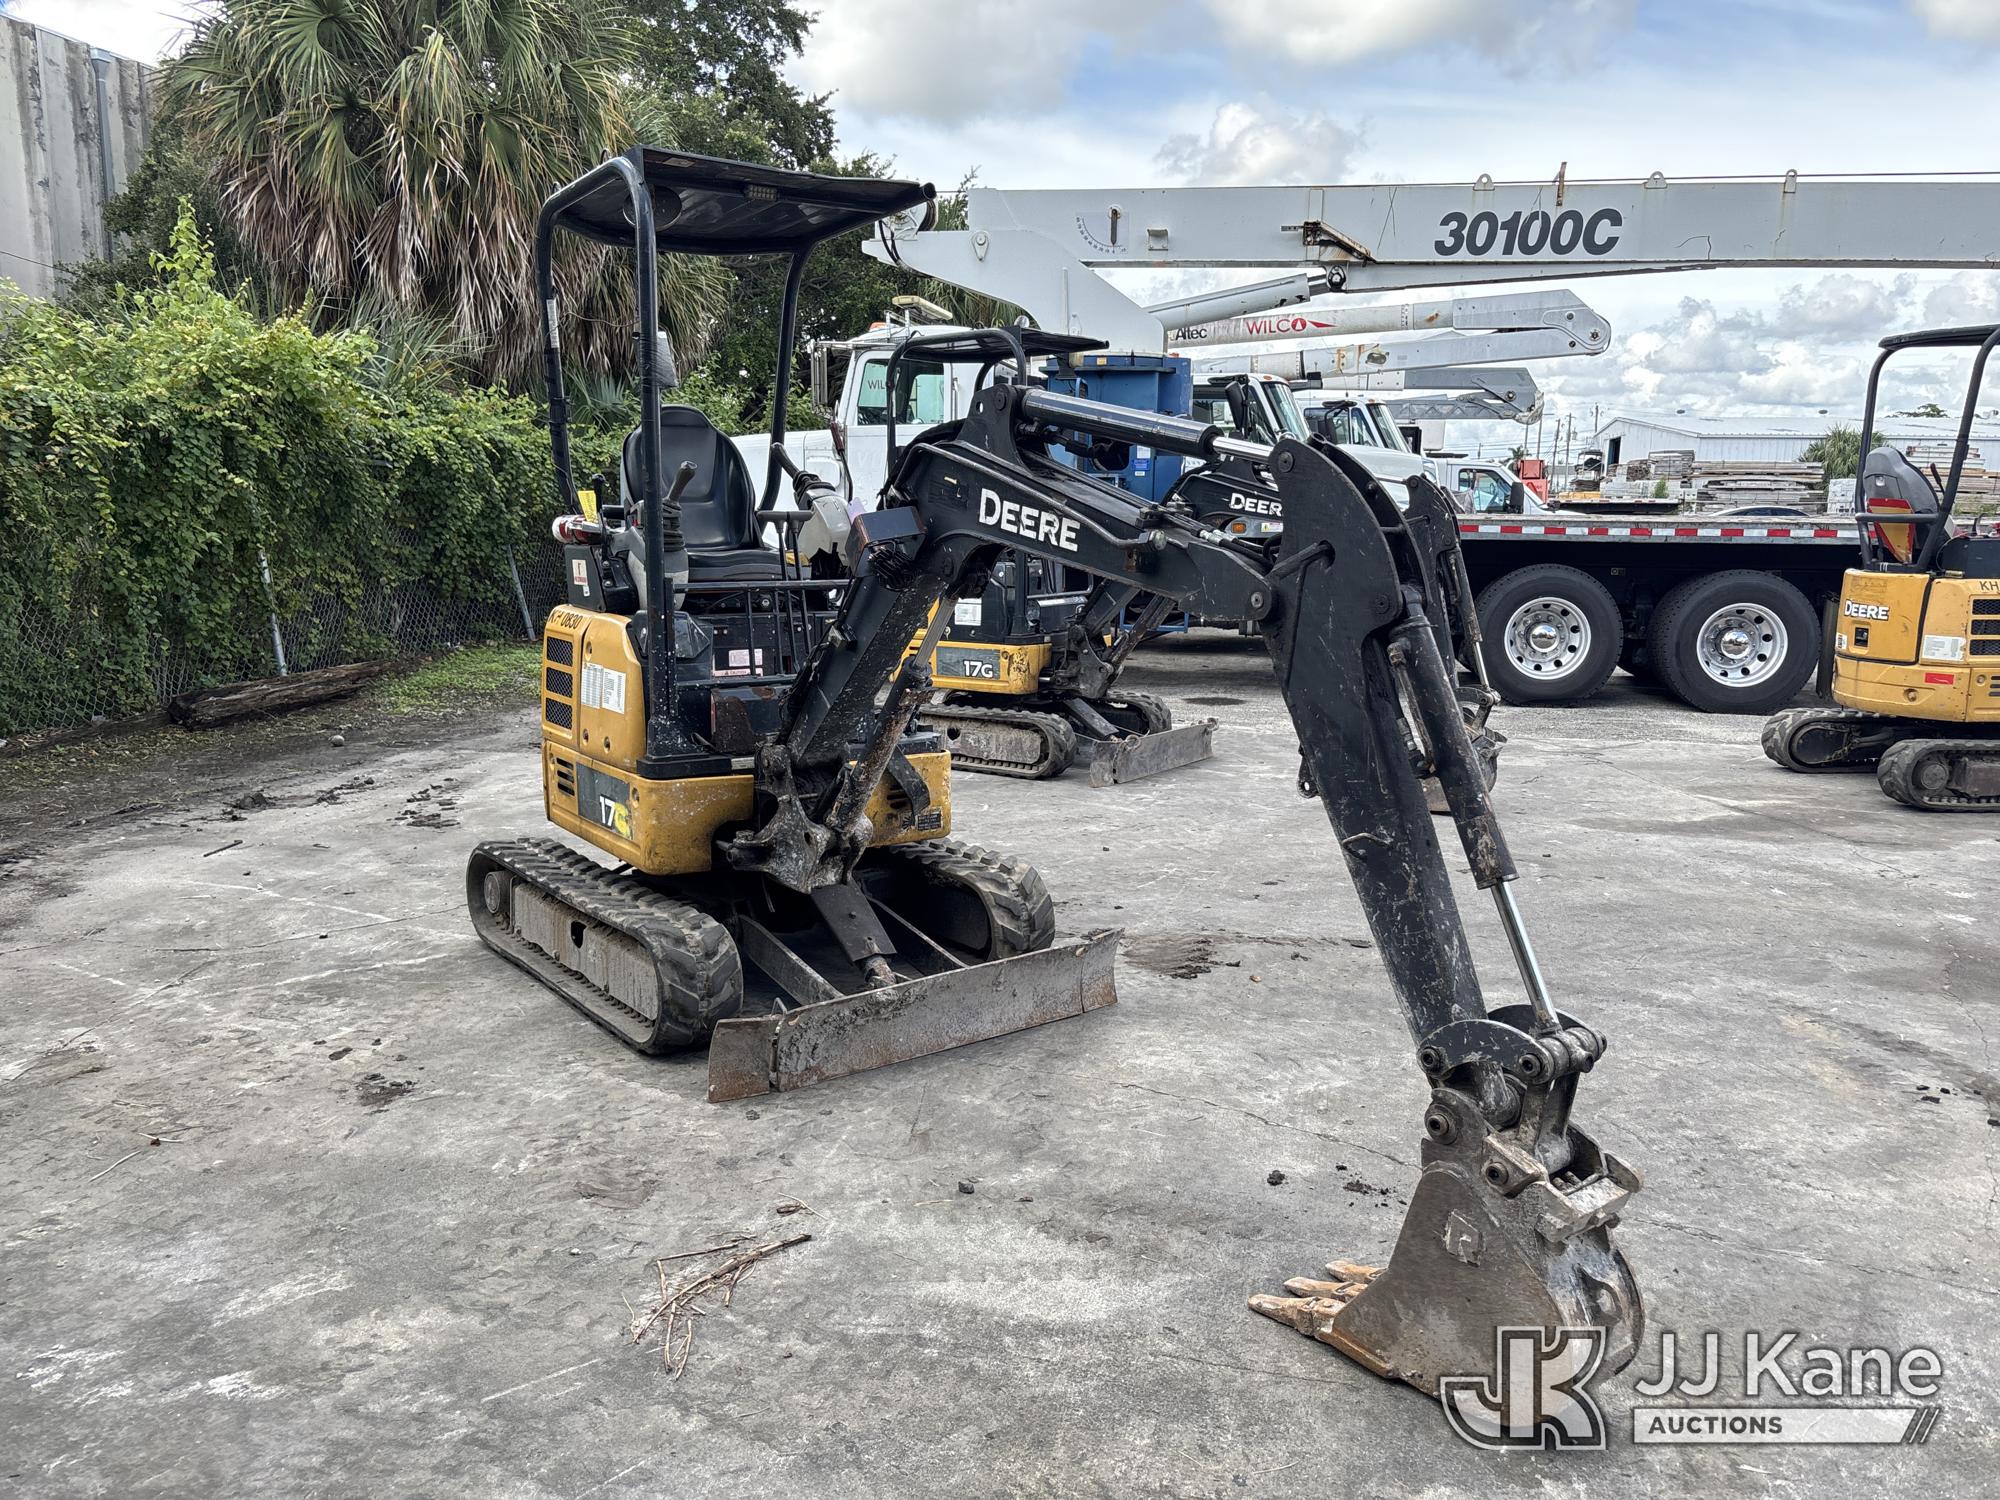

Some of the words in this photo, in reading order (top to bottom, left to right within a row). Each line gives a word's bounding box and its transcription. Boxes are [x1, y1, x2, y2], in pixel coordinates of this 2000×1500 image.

[1434, 208, 1623, 257] 30100C
[1175, 326, 1208, 341] Altec
[1246, 317, 1307, 335] WILCO
[1229, 492, 1283, 517] DEER
[978, 487, 1081, 553] DEERE
[1979, 580, 2000, 592] KH
[1844, 599, 1890, 620] DEERE
[963, 660, 993, 678] 17G
[599, 795, 631, 838] 17G
